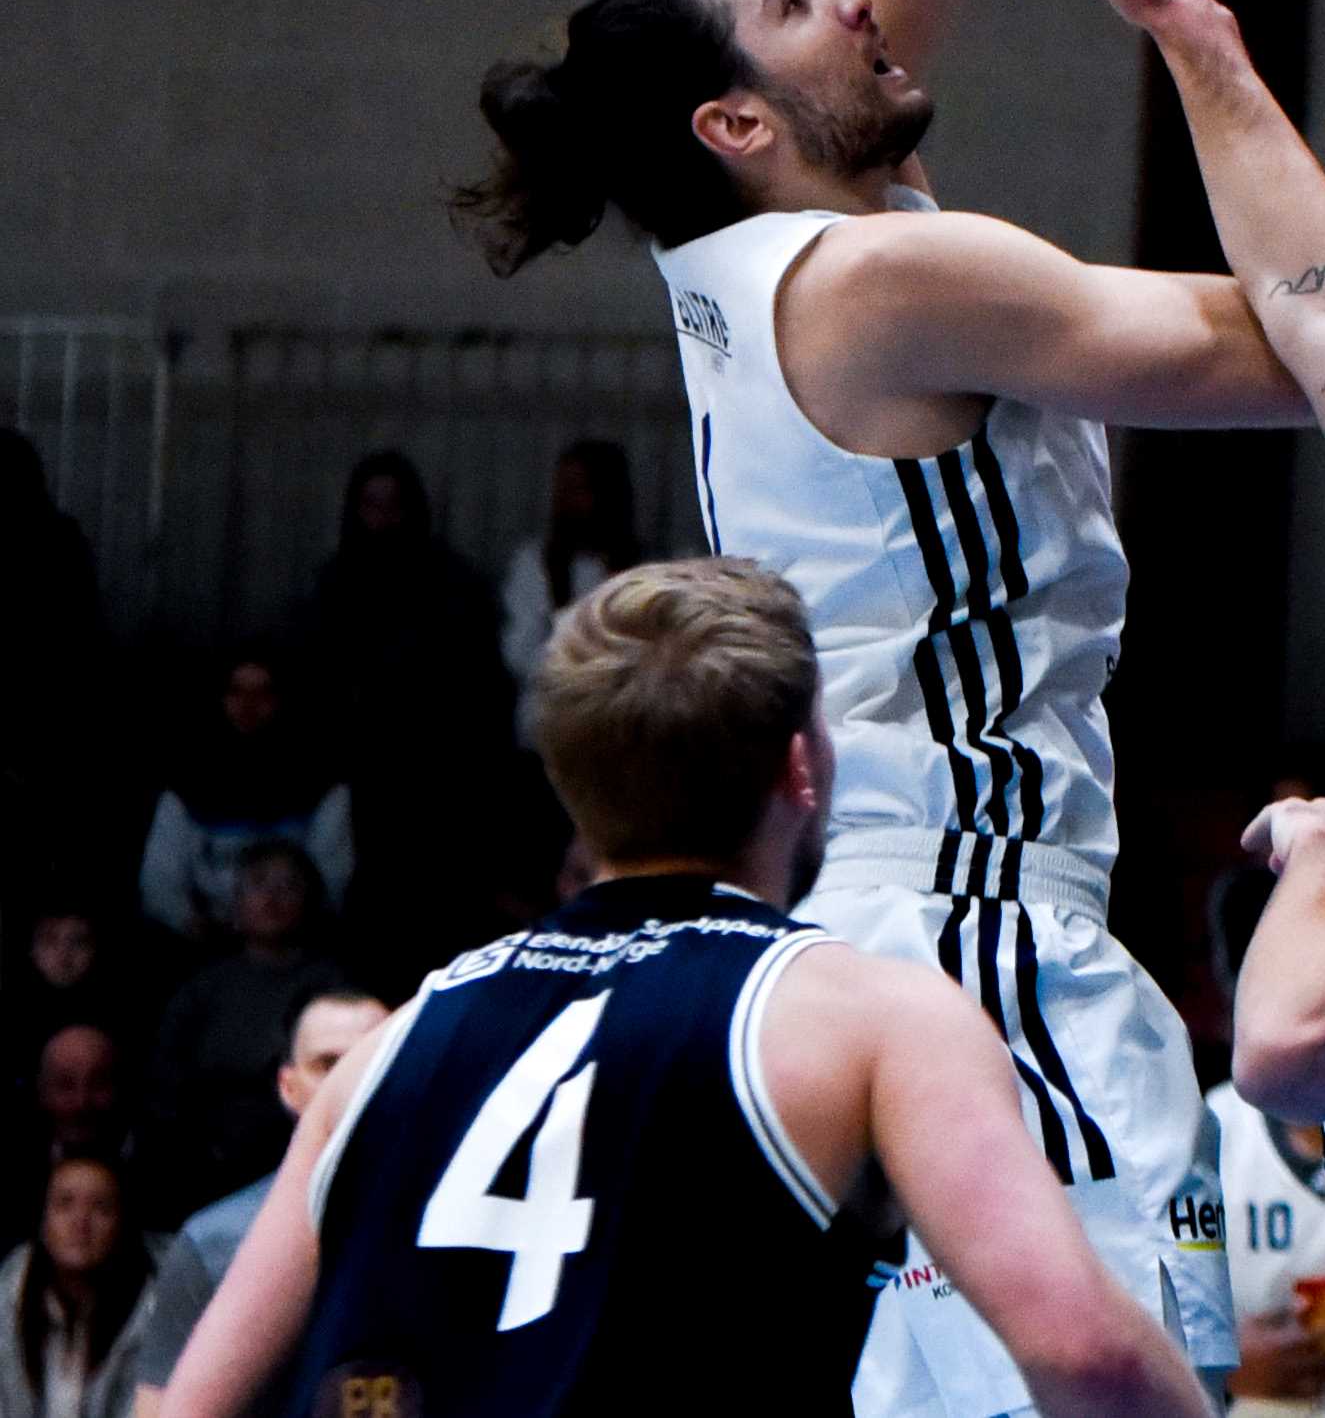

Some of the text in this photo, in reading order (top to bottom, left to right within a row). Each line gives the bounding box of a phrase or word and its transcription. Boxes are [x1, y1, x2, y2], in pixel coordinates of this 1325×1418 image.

[512, 939, 670, 975] Nord-Nge
[415, 987, 614, 1333] 4
[1248, 1200, 1294, 1251] 10
